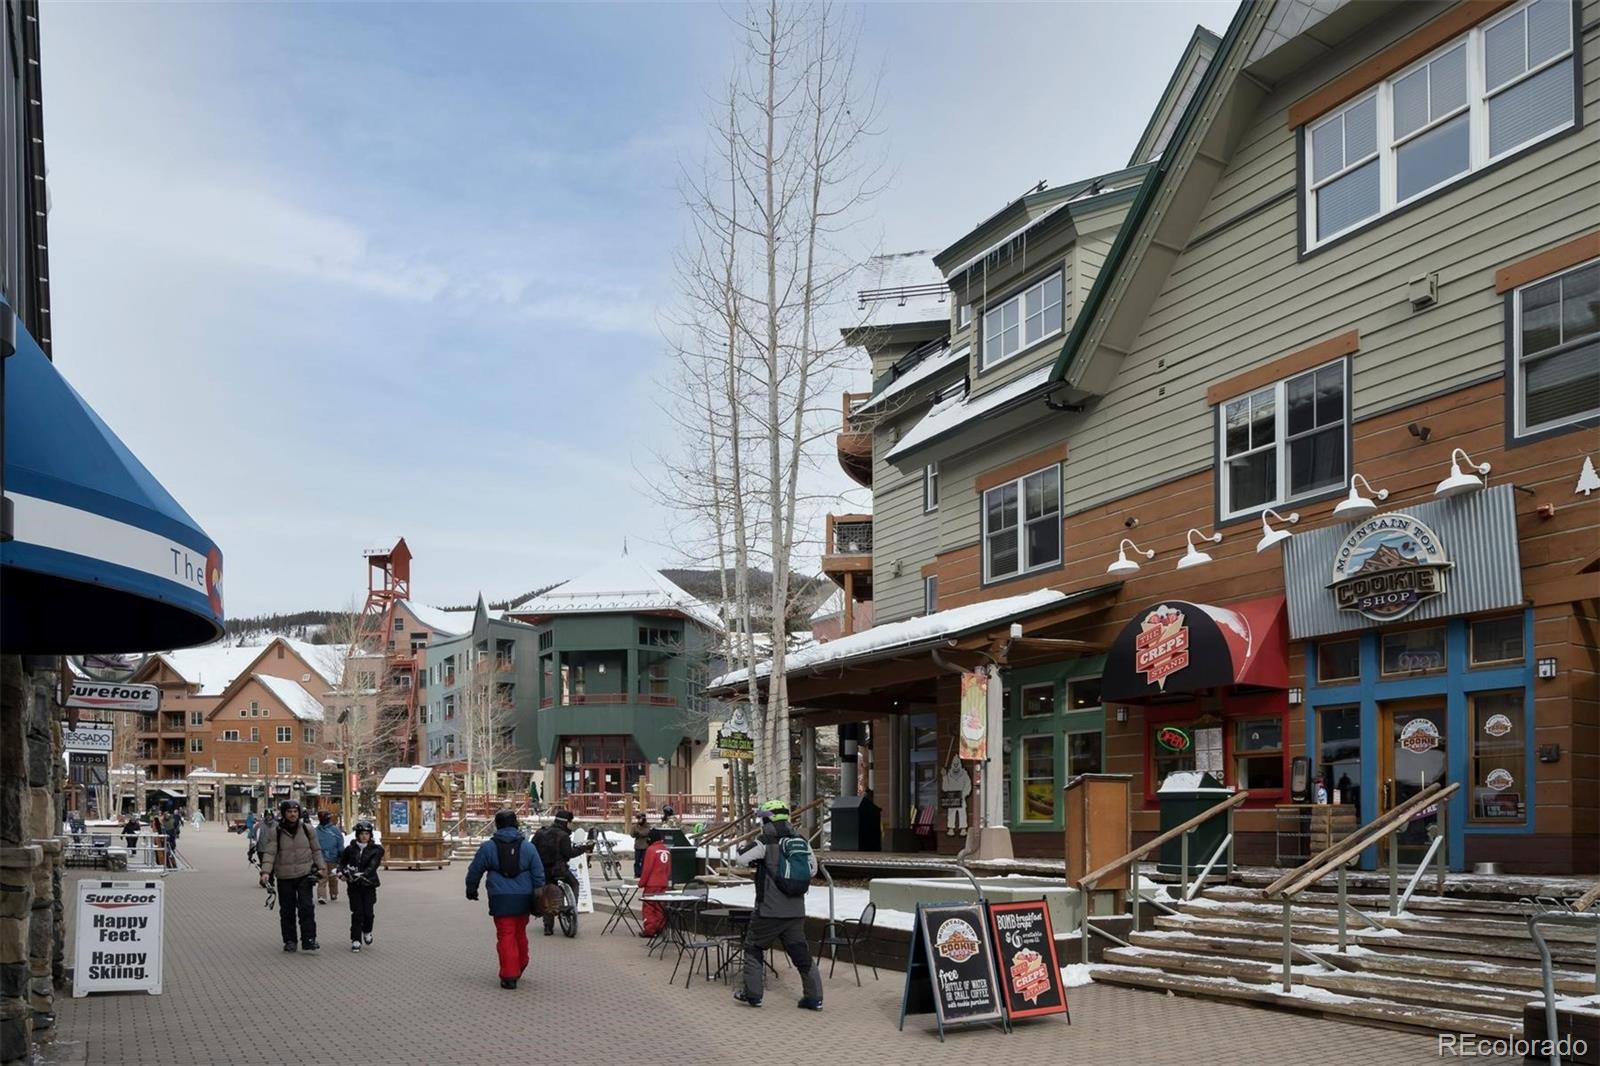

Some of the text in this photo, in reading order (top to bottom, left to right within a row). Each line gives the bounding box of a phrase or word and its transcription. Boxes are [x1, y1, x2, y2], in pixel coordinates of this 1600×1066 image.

[1337, 519, 1436, 573] MOUNTAIN TOP
[170, 547, 204, 586] The
[1337, 569, 1435, 605] COOKIE
[1363, 592, 1410, 608] SHOP
[1140, 629, 1160, 644] THE
[1140, 634, 1185, 665] CREPE
[1151, 657, 1185, 678] STAND
[1160, 731, 1187, 749] OPEN
[1404, 738, 1436, 747] COOKIE
[85, 894, 156, 903] Surefoot
[93, 914, 148, 929] Happy
[996, 914, 1017, 929] BOMB
[99, 929, 141, 942] Feet.
[941, 942, 977, 954] COOKIE
[92, 952, 147, 966] Happy
[88, 965, 149, 980] Skiing.
[939, 969, 959, 989] free
[1016, 968, 1045, 987] CREPE
[945, 980, 963, 992] BOTTLE
